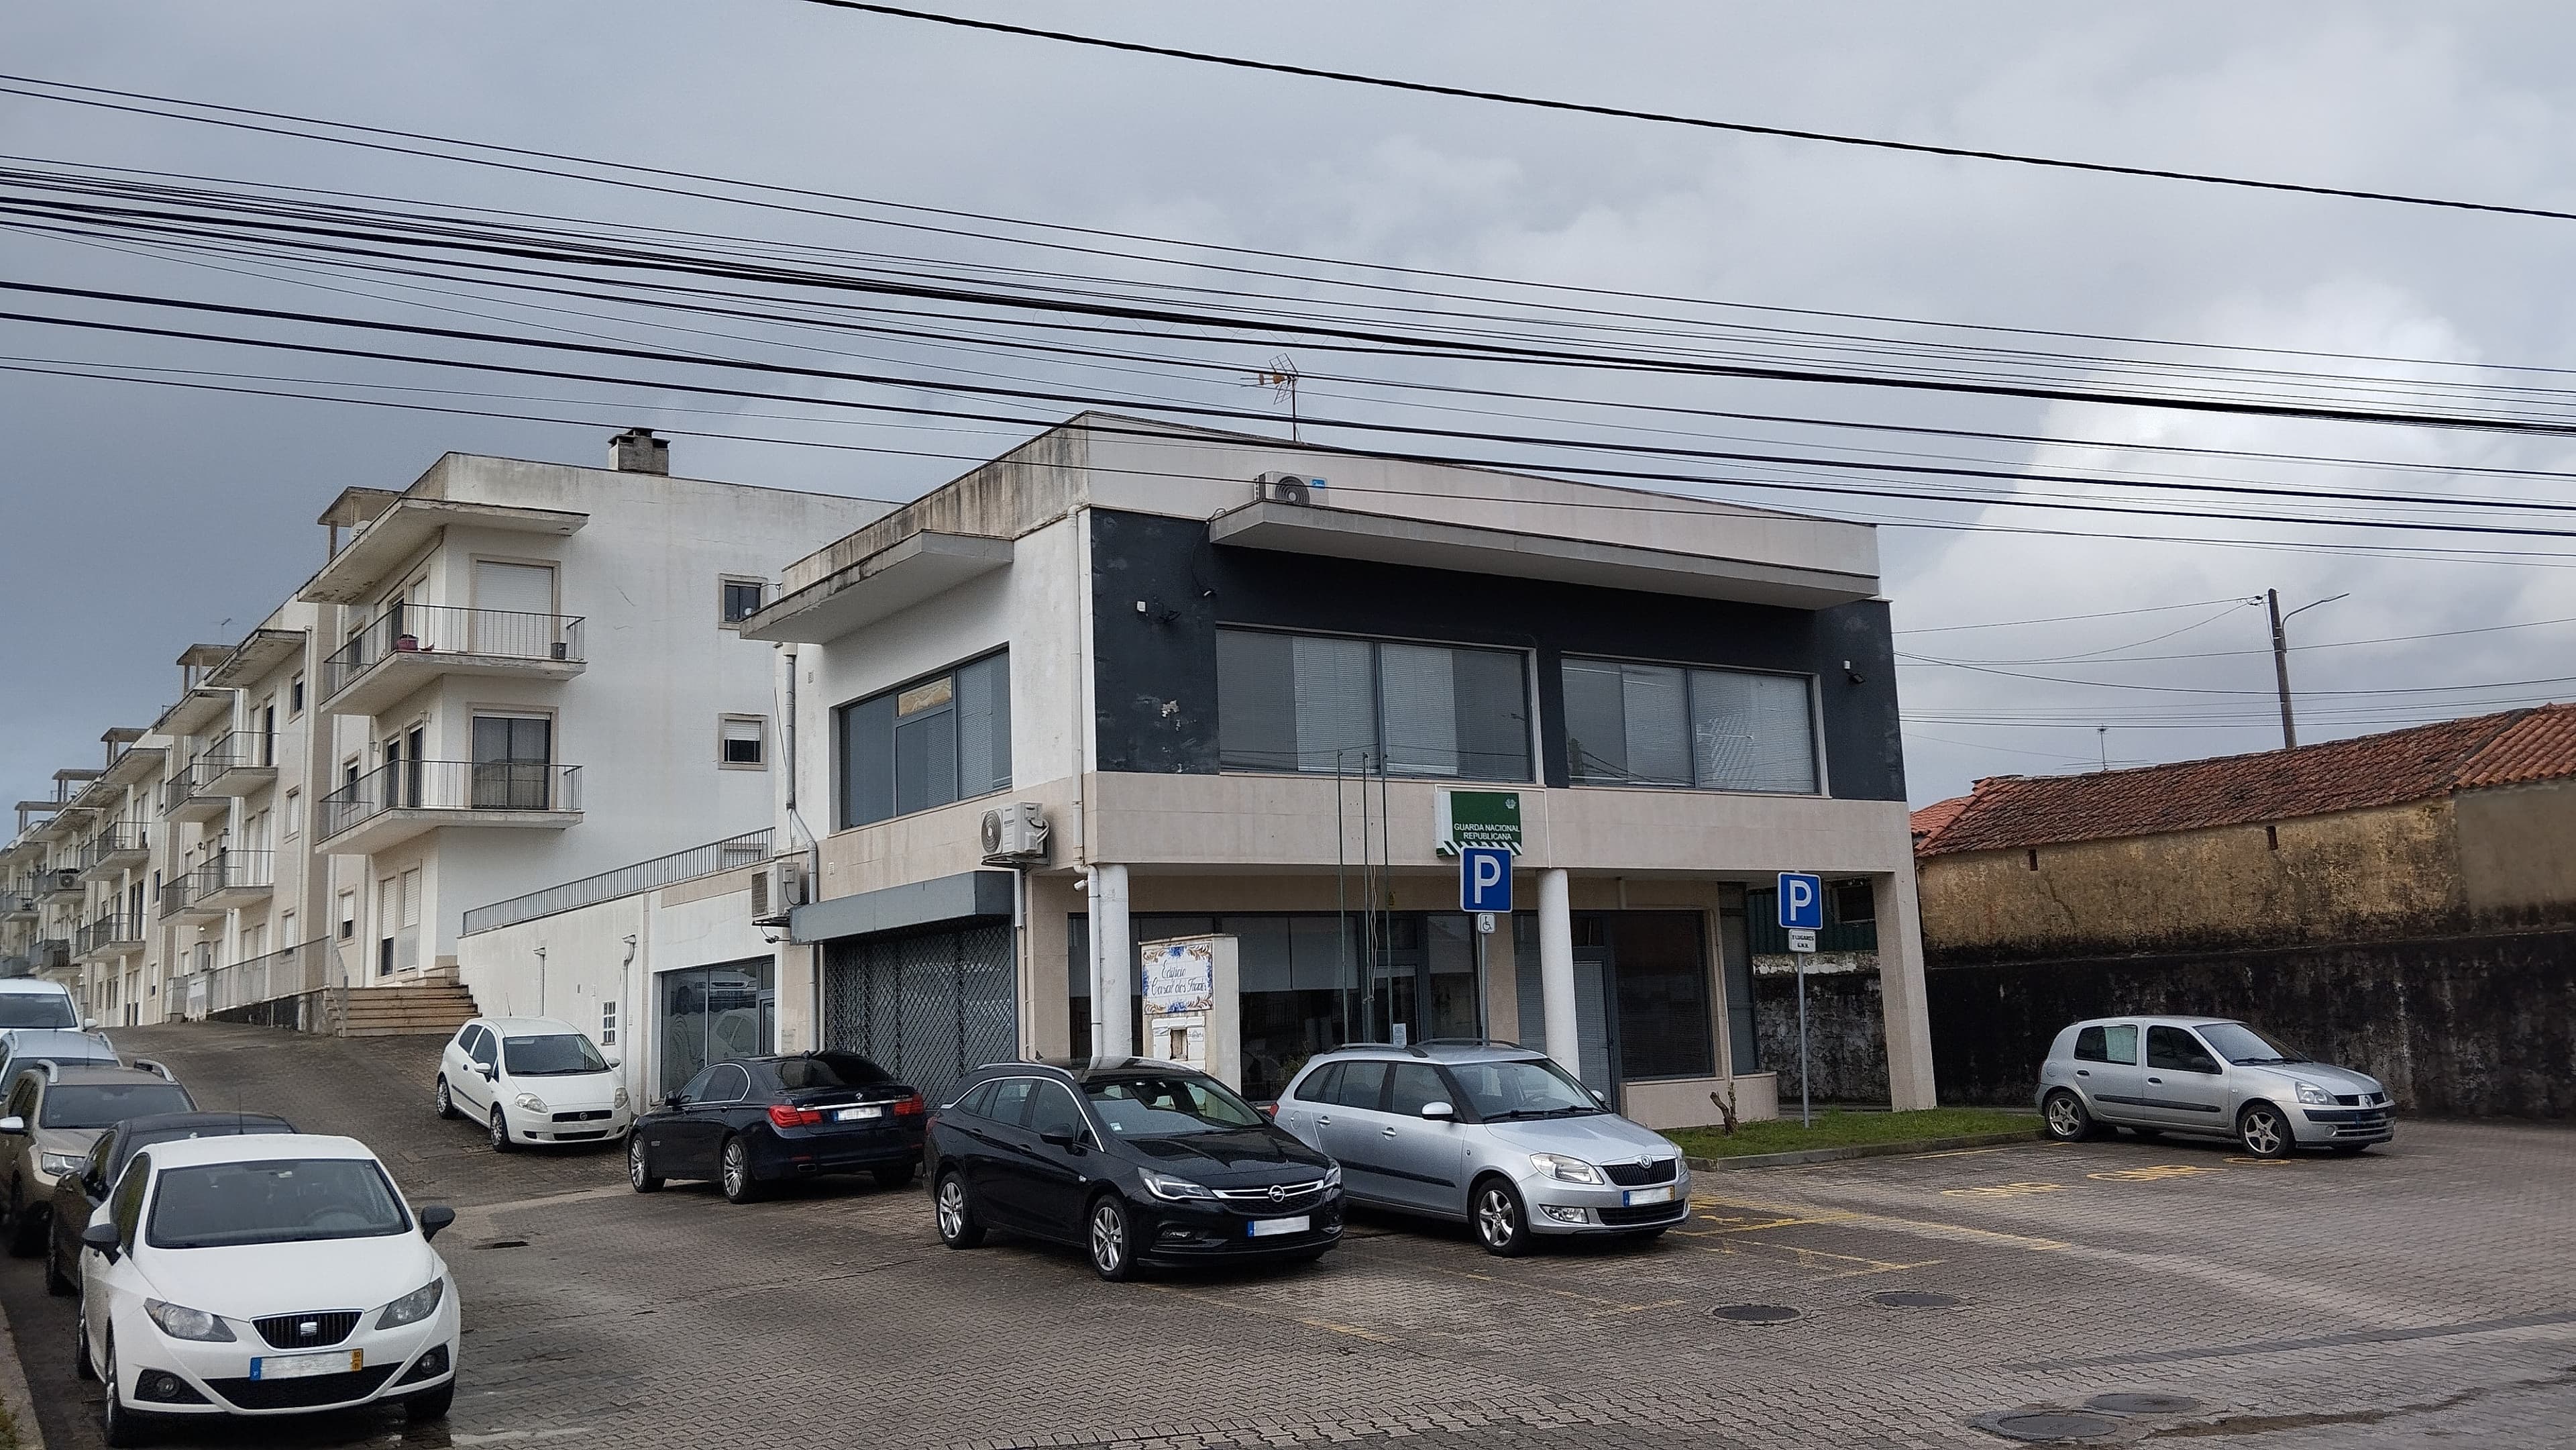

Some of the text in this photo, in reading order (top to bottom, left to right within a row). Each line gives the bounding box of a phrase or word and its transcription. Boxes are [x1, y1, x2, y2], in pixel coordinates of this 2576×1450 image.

[1454, 823, 1521, 832] GUARDA NACIONAL
[1463, 832, 1513, 841] REPUBLICANA
[1474, 854, 1501, 904] P
[1789, 880, 1812, 921] P
[1175, 980, 1186, 993] dos
